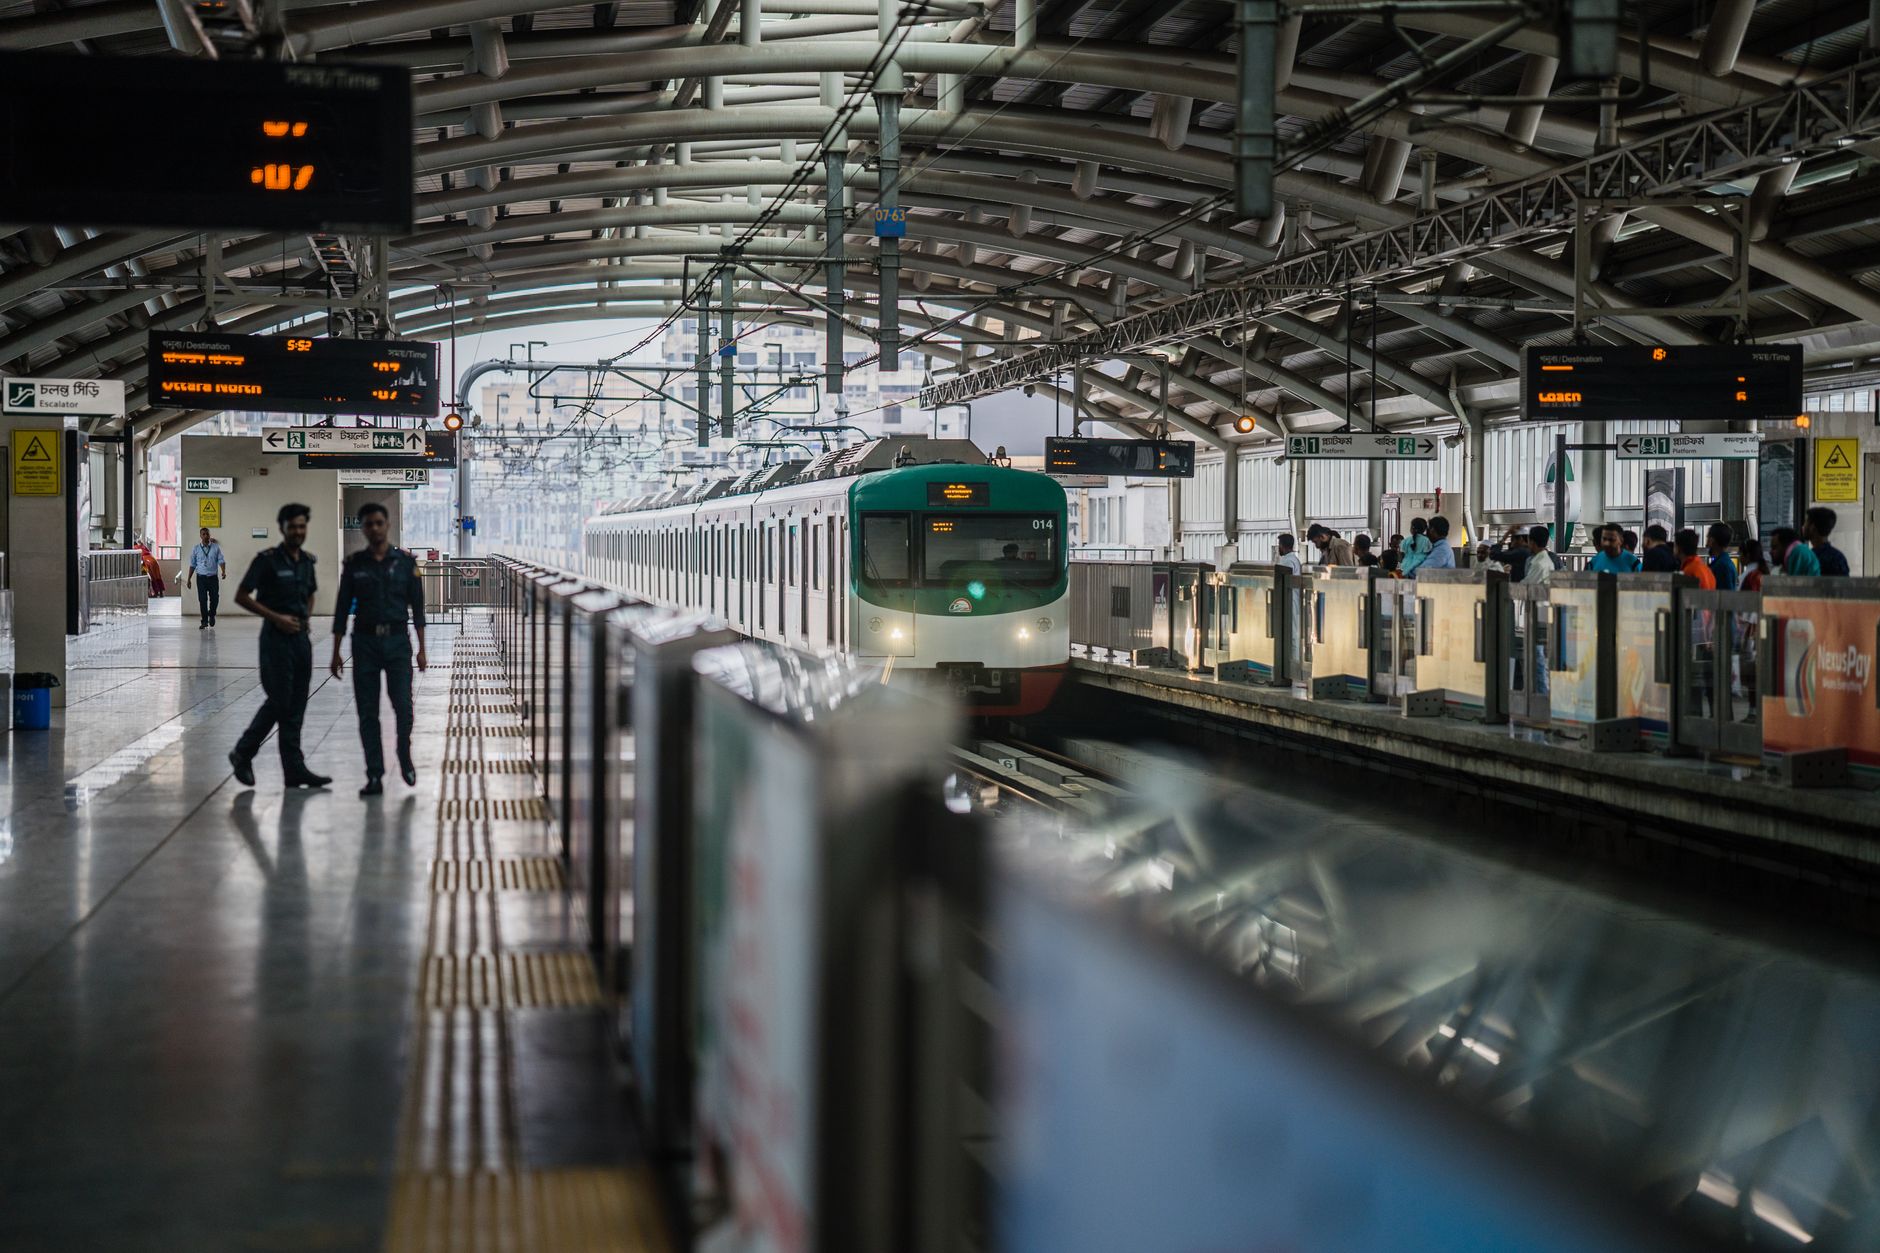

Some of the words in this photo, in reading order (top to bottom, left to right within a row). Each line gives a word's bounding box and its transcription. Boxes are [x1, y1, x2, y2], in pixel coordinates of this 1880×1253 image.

[39, 400, 79, 408] Escalator
[309, 429, 332, 440] বাহির
[1032, 519, 1053, 529] 014
[1818, 642, 1871, 688] NexusPay
